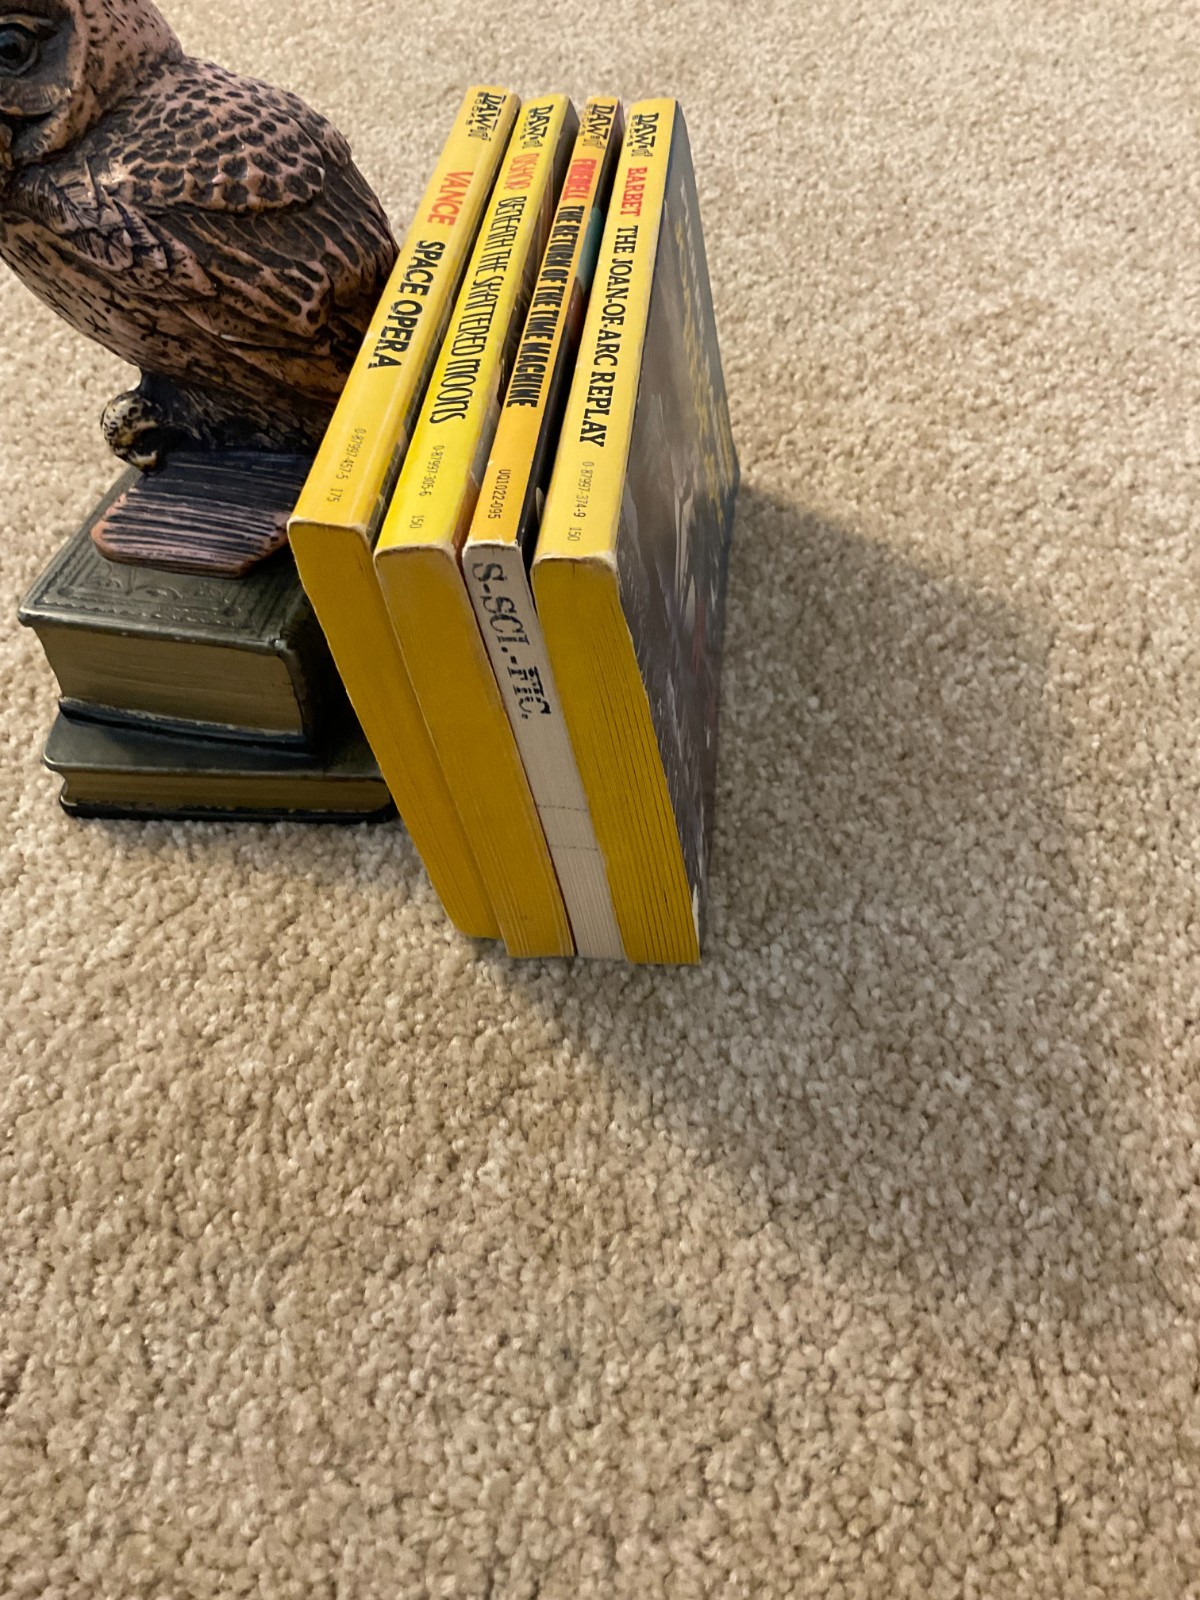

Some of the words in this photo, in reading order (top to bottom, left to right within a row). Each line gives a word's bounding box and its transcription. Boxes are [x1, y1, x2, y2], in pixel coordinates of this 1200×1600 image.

[475, 92, 507, 132] DAW
[527, 104, 554, 138] DAW
[586, 104, 615, 140] DAW
[634, 112, 660, 147] DAW
[426, 171, 474, 227] VANCE
[620, 167, 648, 217] BARBET
[484, 195, 527, 250] BENEATH
[554, 204, 585, 226] THE
[544, 225, 579, 268] RETURN
[613, 225, 639, 254] THE
[397, 239, 446, 297] SPACE
[475, 248, 512, 277] THE
[541, 267, 568, 286] OF
[533, 284, 565, 309] THE
[367, 299, 423, 369] OPERA
[451, 276, 505, 357] SHATTERED
[524, 309, 558, 341] TIME
[506, 340, 551, 409] MACHINE
[579, 371, 616, 448] REPLAY
[327, 488, 344, 502] 175
[409, 515, 425, 529] 150
[568, 527, 582, 542] 150
